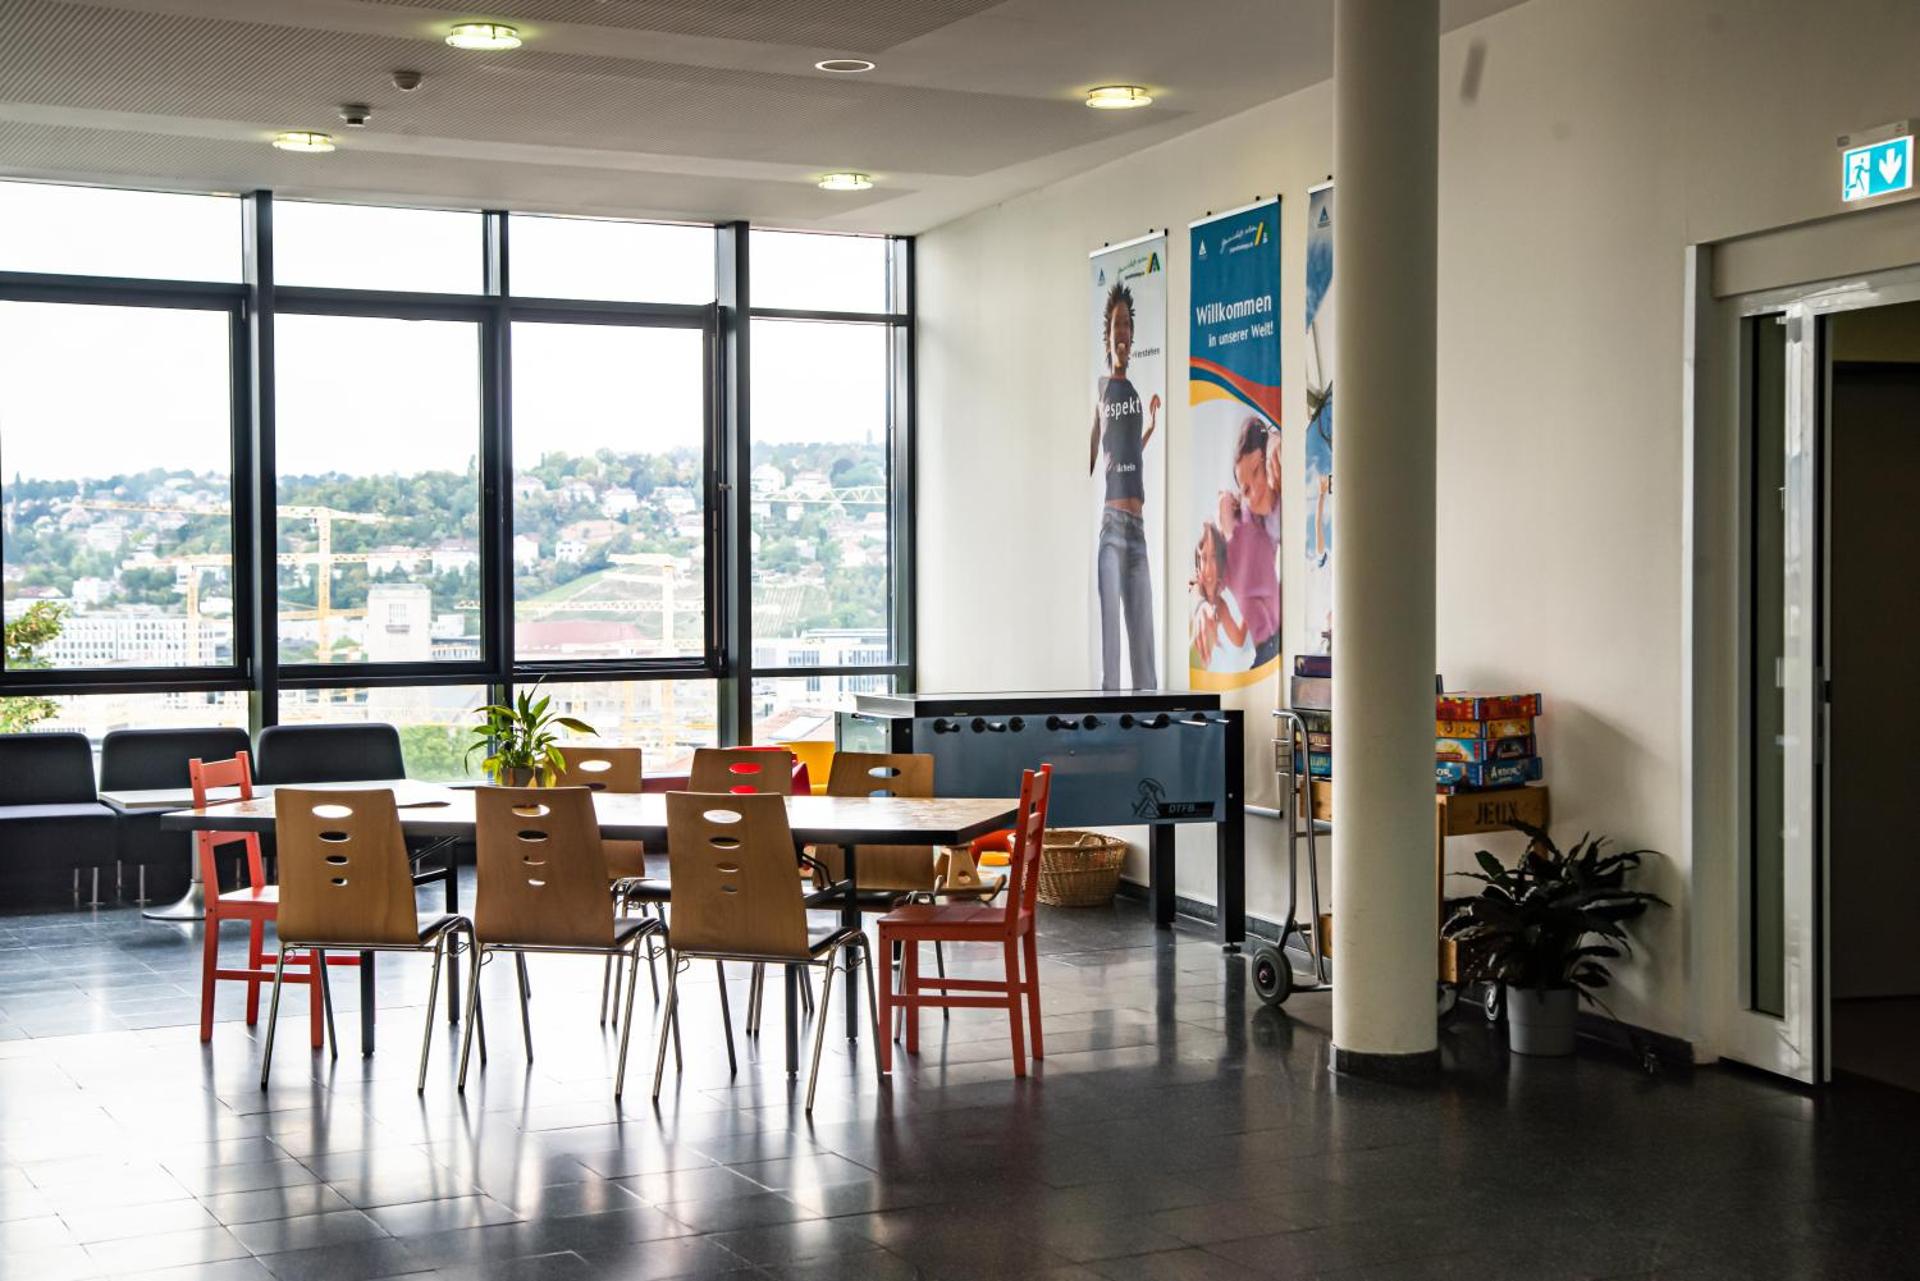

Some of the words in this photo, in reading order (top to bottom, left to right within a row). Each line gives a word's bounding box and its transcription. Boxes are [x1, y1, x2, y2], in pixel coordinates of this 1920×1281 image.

[1196, 295, 1272, 326] Willkommen
[1208, 333, 1217, 348] in
[1219, 328, 1249, 345] unserer
[1251, 320, 1274, 338] Welt!
